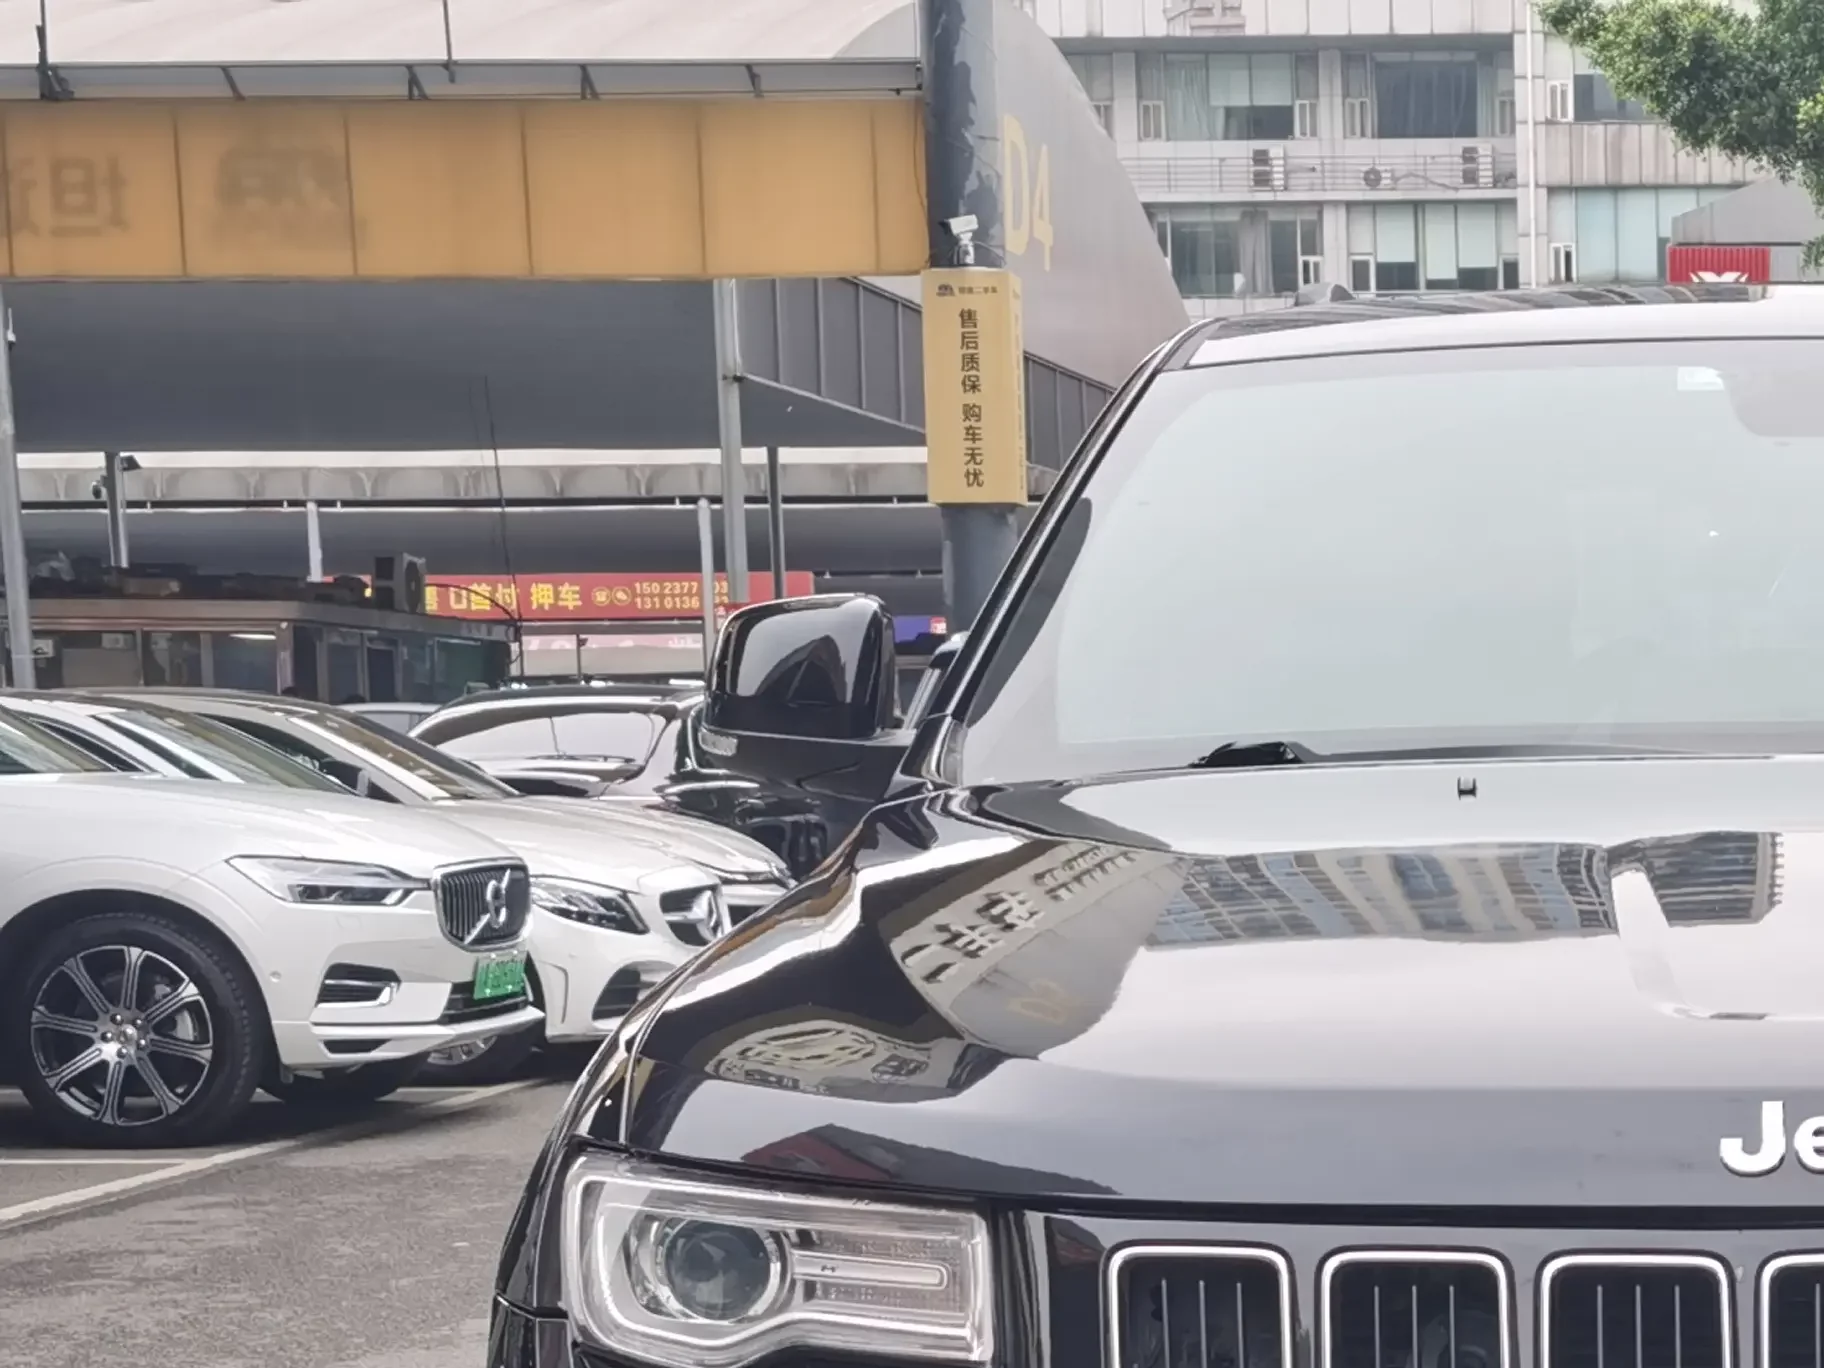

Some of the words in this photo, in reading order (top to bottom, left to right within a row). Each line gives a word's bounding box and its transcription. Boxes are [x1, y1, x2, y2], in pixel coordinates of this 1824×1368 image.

[1003, 114, 1054, 273] D4
[959, 307, 981, 395] 售后质保
[962, 402, 984, 488] 购车无忧
